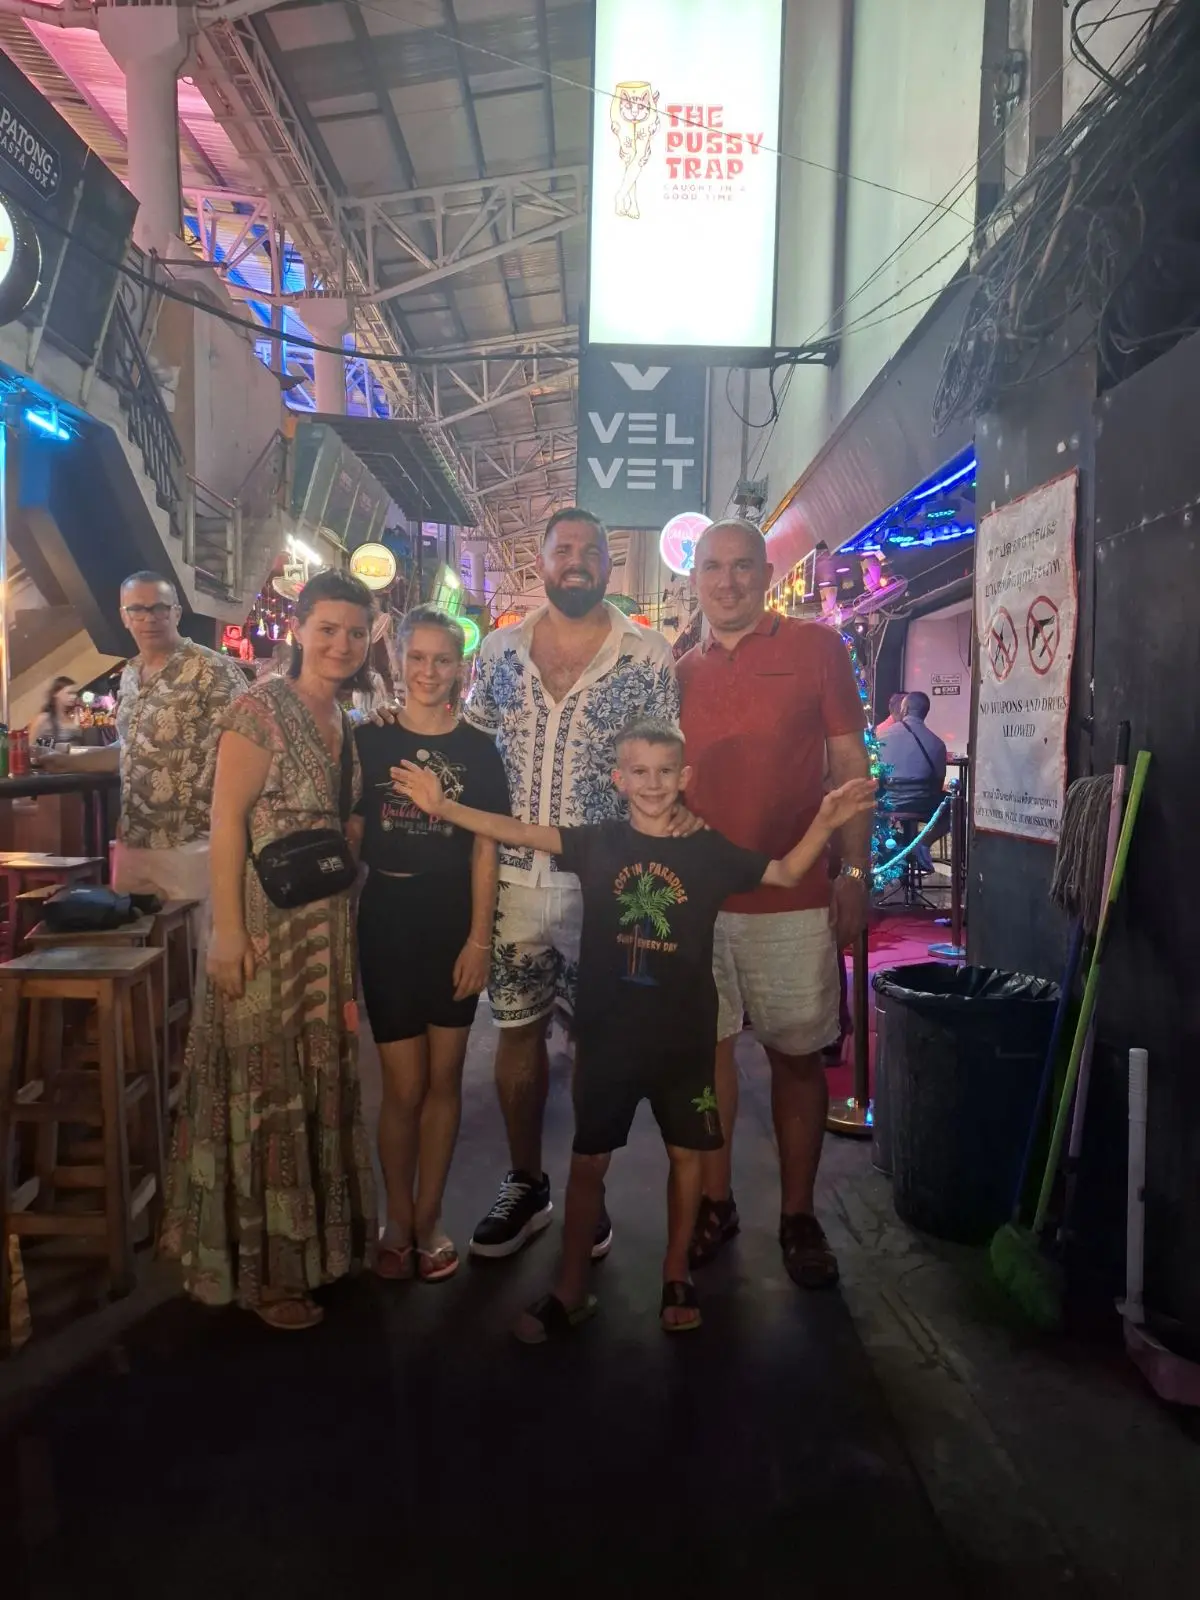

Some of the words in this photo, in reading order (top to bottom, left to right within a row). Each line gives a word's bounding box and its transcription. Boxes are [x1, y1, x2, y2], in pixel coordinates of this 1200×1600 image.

[666, 104, 724, 128] THE
[0, 107, 54, 175] PATONG
[666, 131, 764, 155] PUSSY
[28, 162, 49, 188] BOX
[666, 157, 744, 180] TRAP
[588, 411, 695, 445] VEL
[587, 457, 695, 490] VET
[980, 702, 989, 715] NO
[1026, 698, 1041, 712] AND
[1042, 695, 1067, 711] DRUGS
[1002, 723, 1036, 738] ALLOWED
[613, 866, 631, 895] LOST
[631, 863, 643, 876] IN
[648, 862, 688, 904] PARADISE
